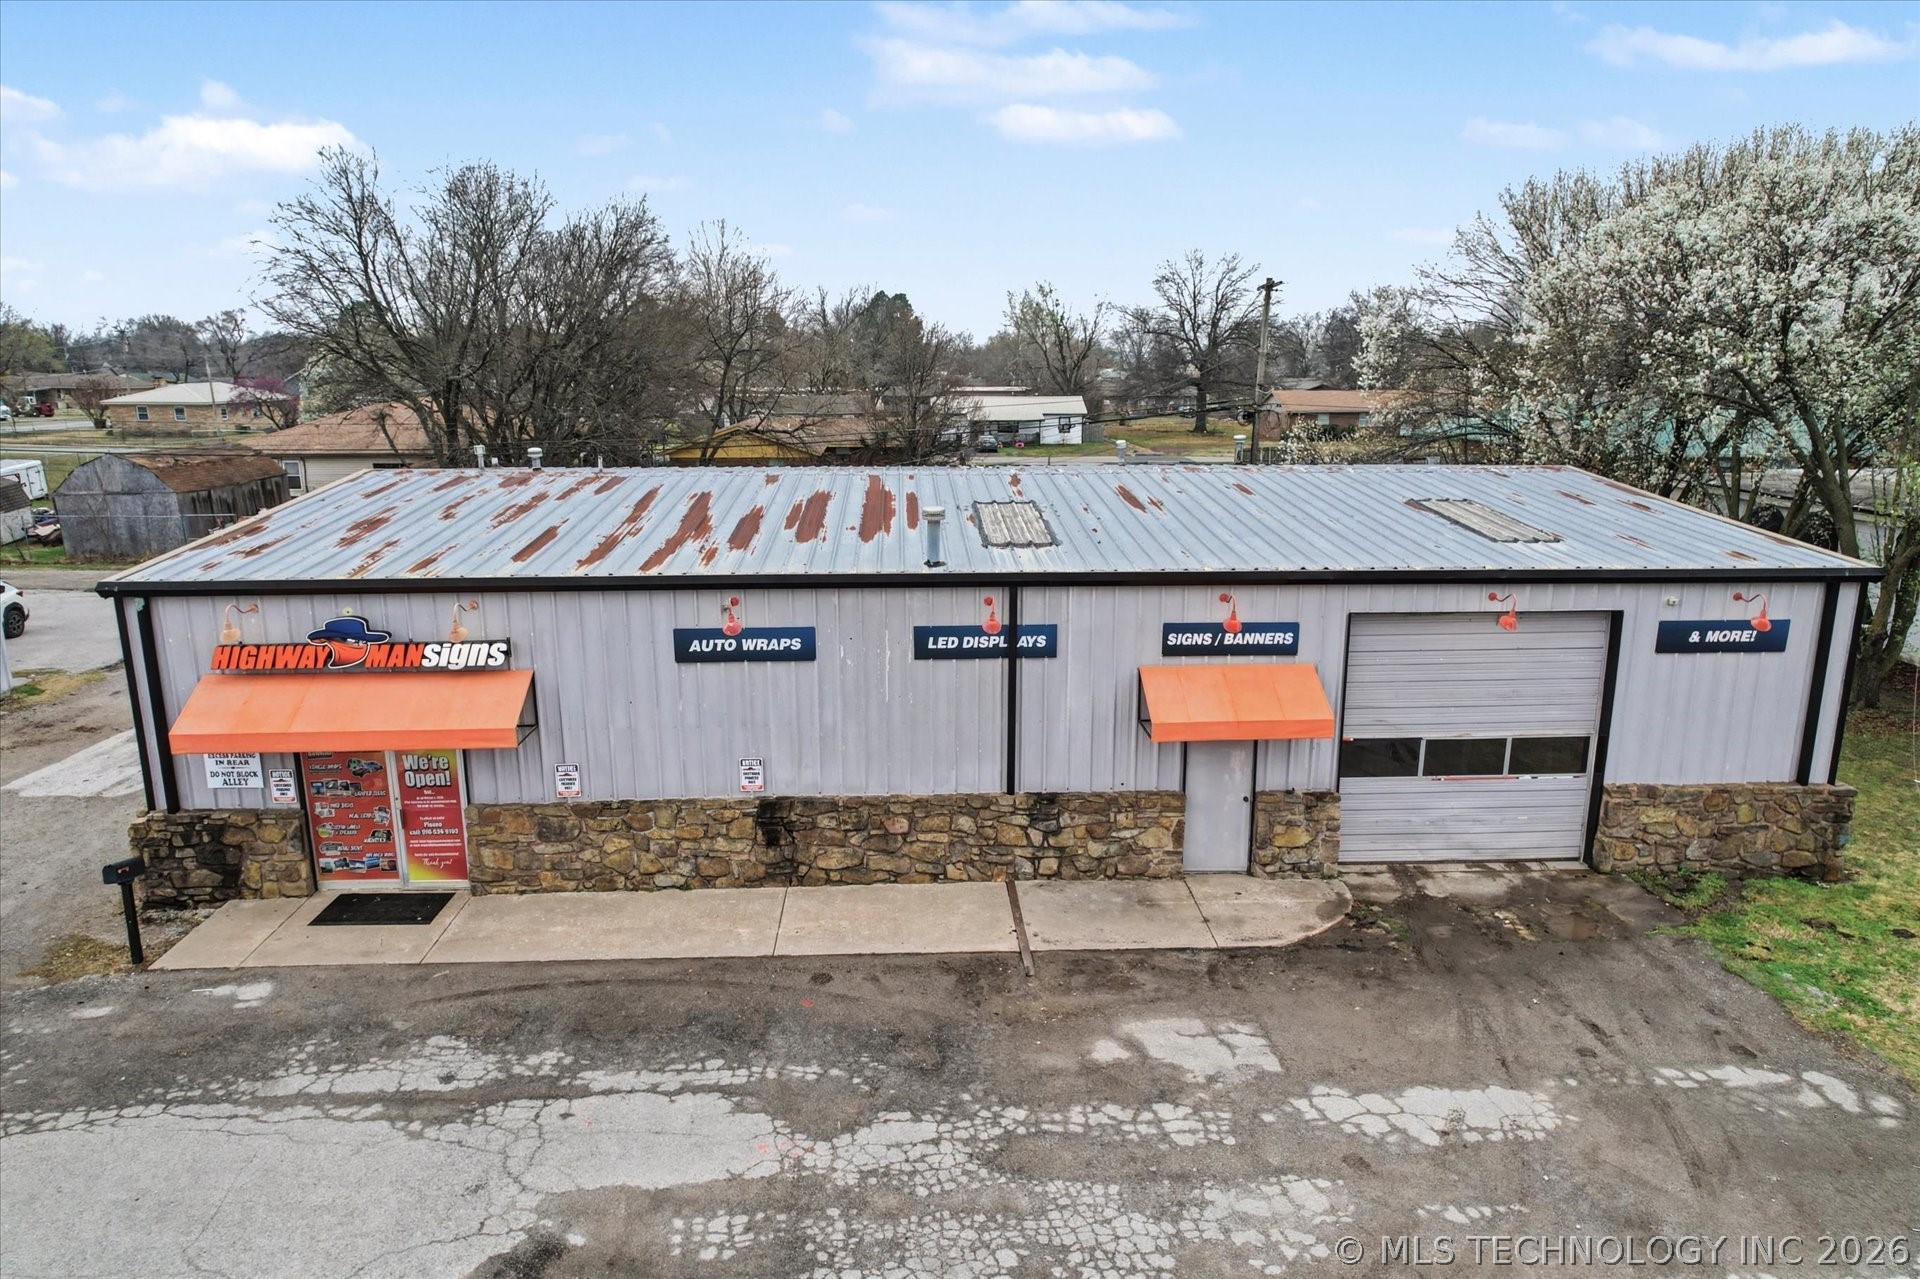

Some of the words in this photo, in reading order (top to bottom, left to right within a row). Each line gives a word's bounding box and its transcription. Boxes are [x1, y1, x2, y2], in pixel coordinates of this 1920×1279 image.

[928, 636, 959, 649] LED
[962, 635, 1047, 648] DISPLAYS
[1167, 633, 1213, 645] SIGNS
[1214, 633, 1222, 646] /
[1223, 632, 1294, 645] BANNERS
[1688, 631, 1701, 643] &
[1705, 630, 1757, 643] MORE!
[689, 639, 737, 652] AUTO
[741, 638, 802, 651] WRAPS
[211, 645, 330, 670] HIGHWAY
[402, 754, 449, 770] We're
[222, 778, 249, 786] ALLEY
[404, 770, 451, 788] Open!
